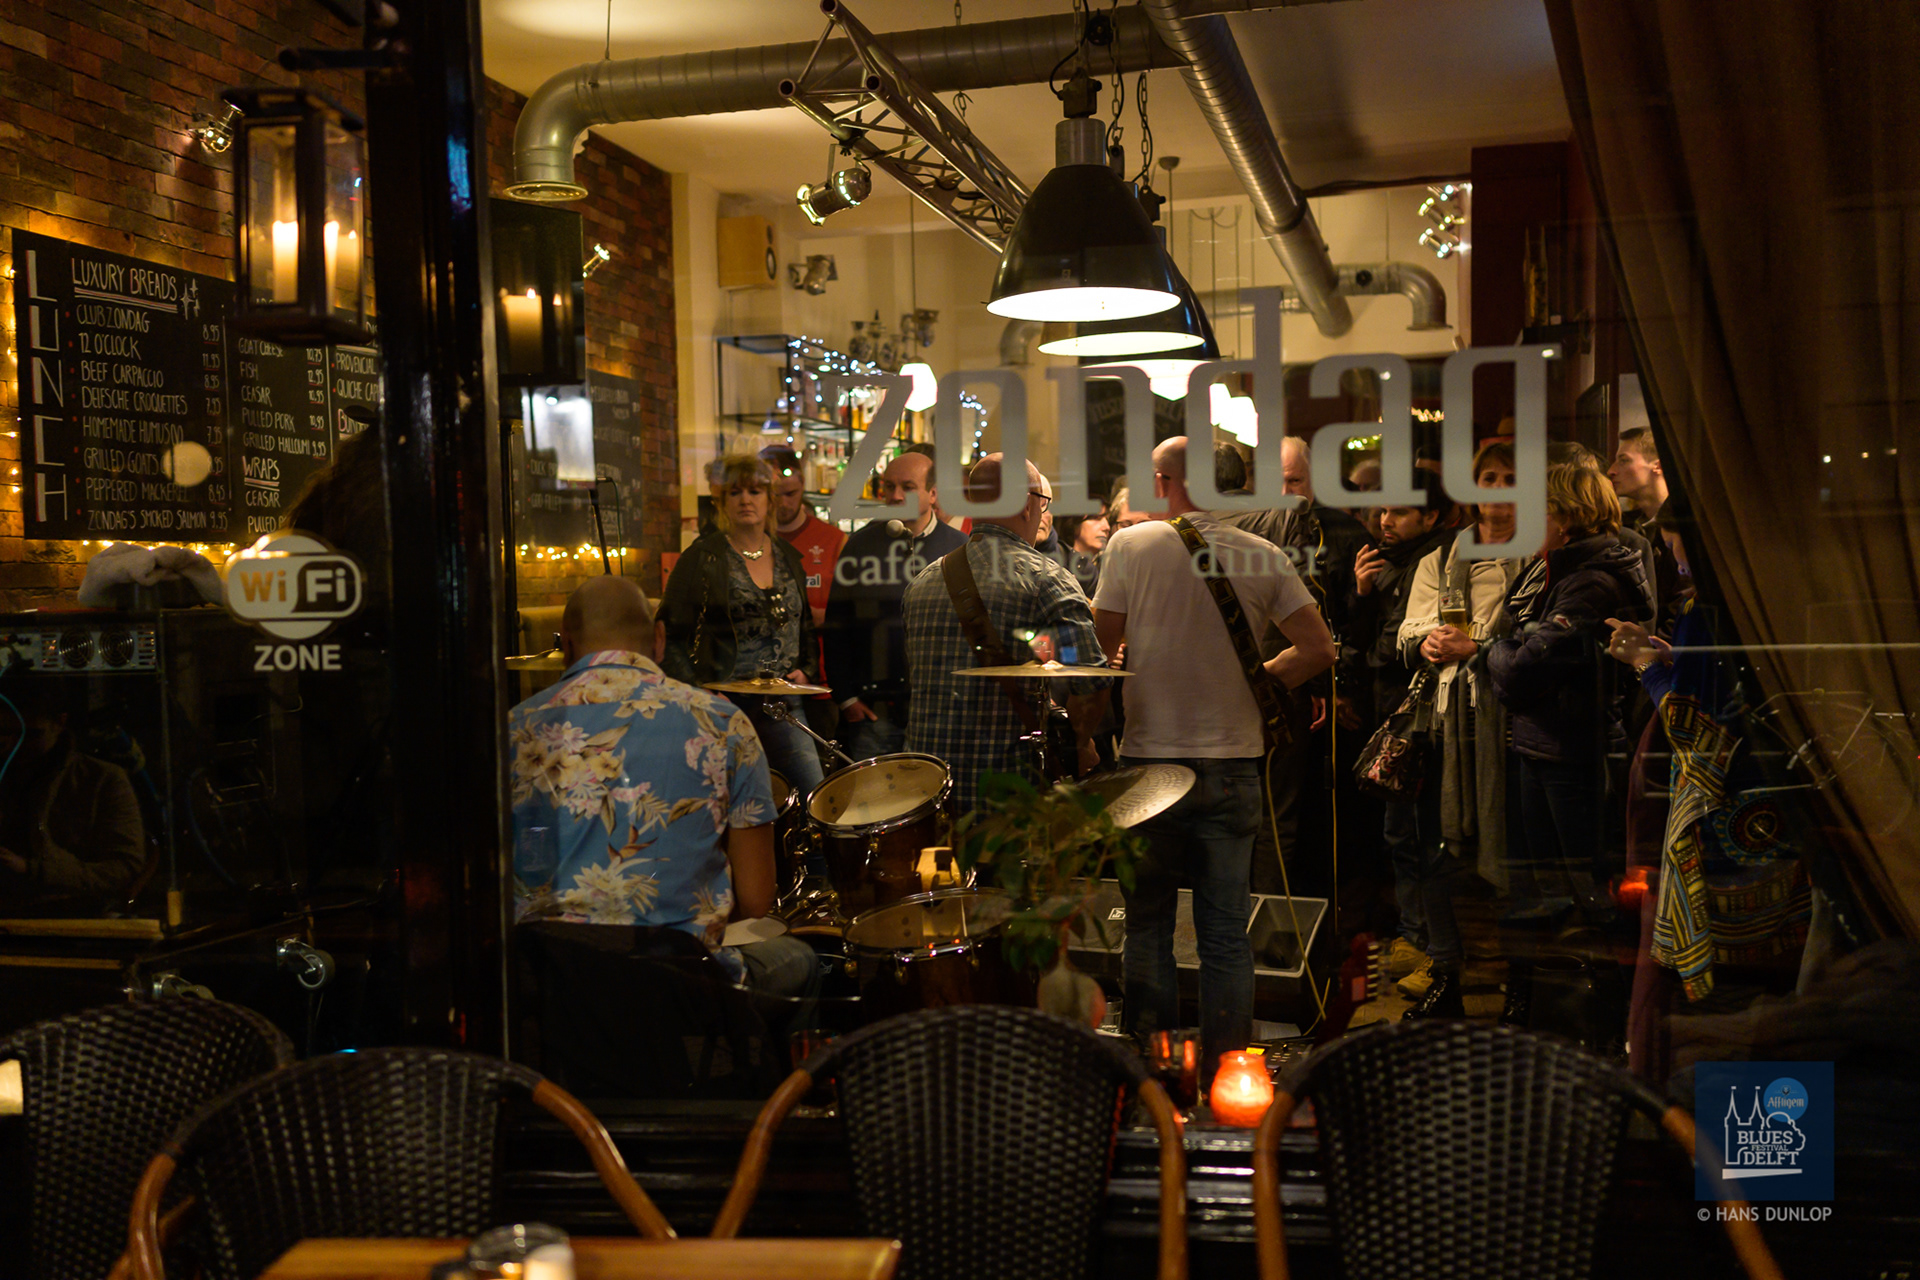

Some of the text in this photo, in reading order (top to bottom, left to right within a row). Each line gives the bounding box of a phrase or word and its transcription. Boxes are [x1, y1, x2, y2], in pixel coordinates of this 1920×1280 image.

[71, 257, 178, 301] LUXURY BREADS
[202, 325, 220, 342] 8.95
[78, 332, 142, 361] 12 O'CLOCK
[81, 360, 164, 388] BEEF CARPACCIO
[203, 374, 220, 390] 8.95
[239, 361, 259, 381] FISH
[241, 386, 272, 407] CEASAR
[336, 378, 363, 401] QUICHE
[133, 391, 188, 415] CROQUETTES
[82, 416, 137, 444] HOMEMADE
[241, 407, 296, 433] PULLED PORK
[826, 288, 1561, 560] zondag
[243, 431, 311, 456] GRILLED HALLOUMI
[83, 447, 125, 473] GRILLED
[242, 455, 280, 481] WRAPS
[85, 477, 138, 502] PEPPERED
[245, 490, 281, 508] CEASAR
[140, 509, 174, 529] SMOKED
[176, 509, 207, 530] SALMON
[248, 515, 277, 534] PULLED
[835, 539, 926, 587] café
[1190, 540, 1328, 579] diner
[253, 643, 342, 672] ZONE
